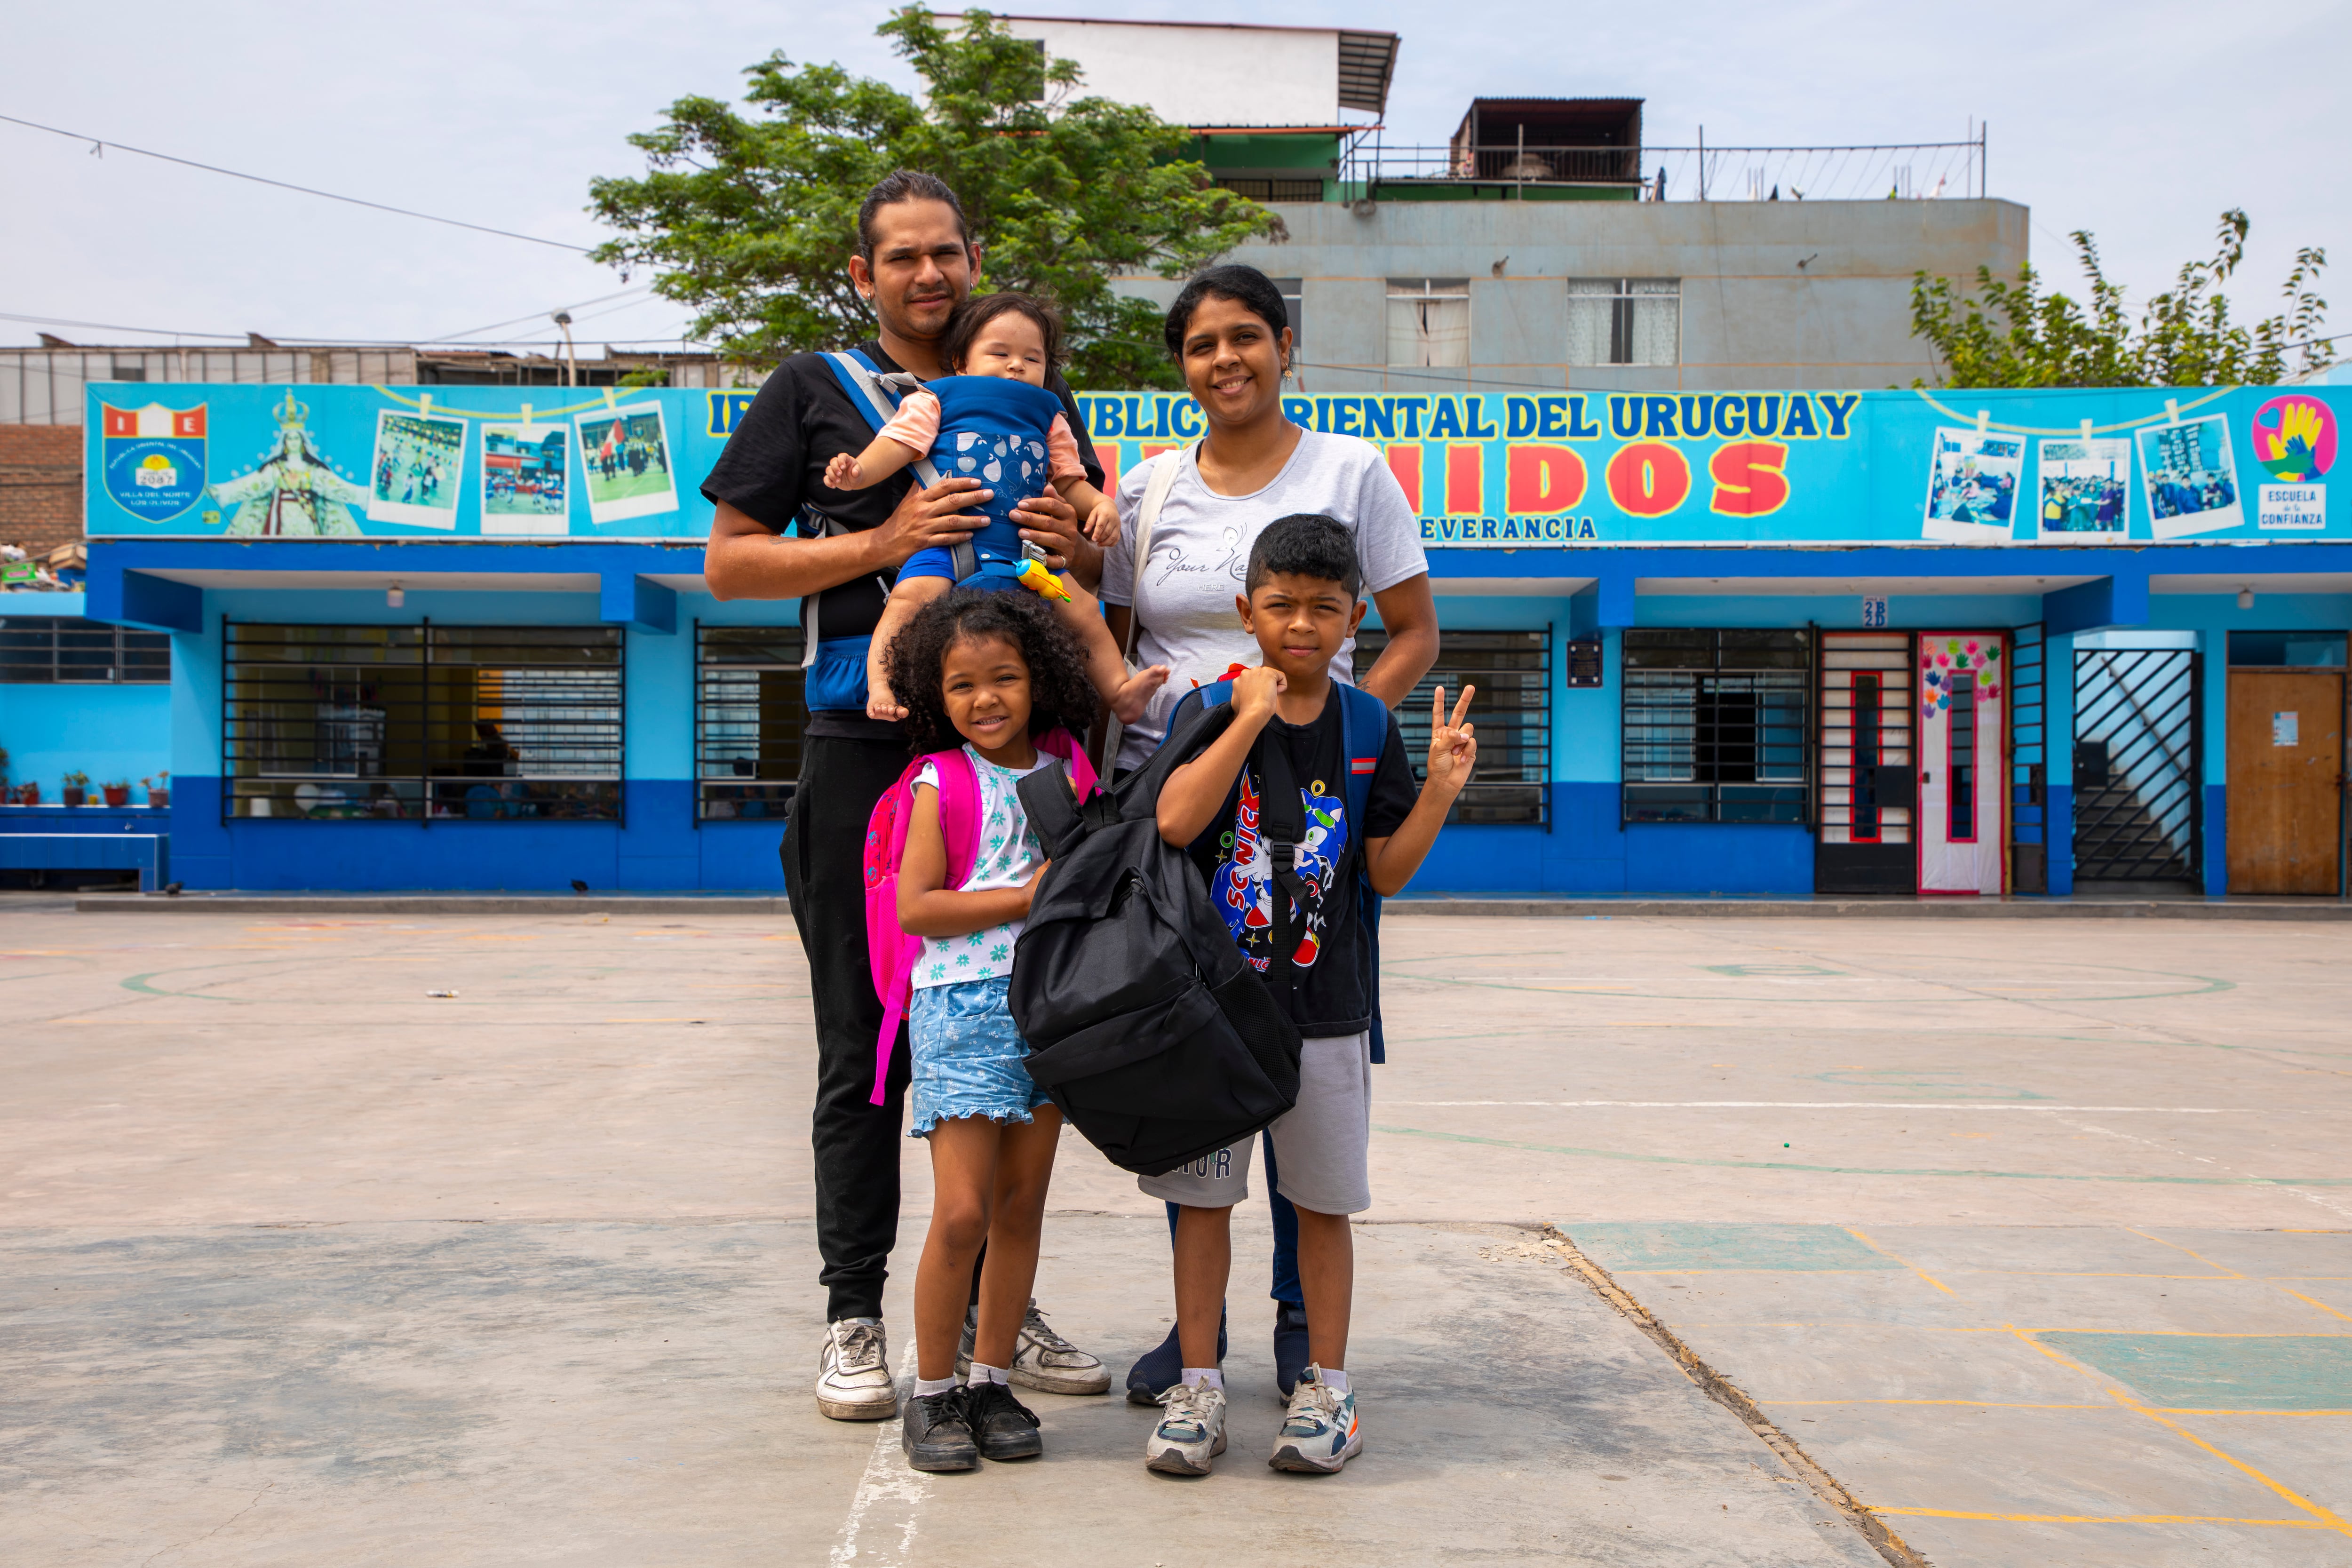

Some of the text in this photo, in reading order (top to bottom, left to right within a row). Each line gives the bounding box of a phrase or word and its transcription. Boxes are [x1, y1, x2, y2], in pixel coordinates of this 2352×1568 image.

[183, 416, 196, 432] E
[1279, 394, 1498, 441] RIENTAL
[1503, 393, 1601, 441] DEL
[1608, 392, 1861, 440] URUGUAY
[140, 475, 173, 485] 2087
[2268, 490, 2317, 502] ESCUELA
[2261, 513, 2323, 525] CONFIANZA
[1419, 517, 1598, 540] EVERANCIA
[1156, 548, 1209, 587] Your
[1226, 804, 1260, 912] SONIC
[1248, 956, 1271, 972] NIC
[1332, 1405, 1342, 1424] adidas
